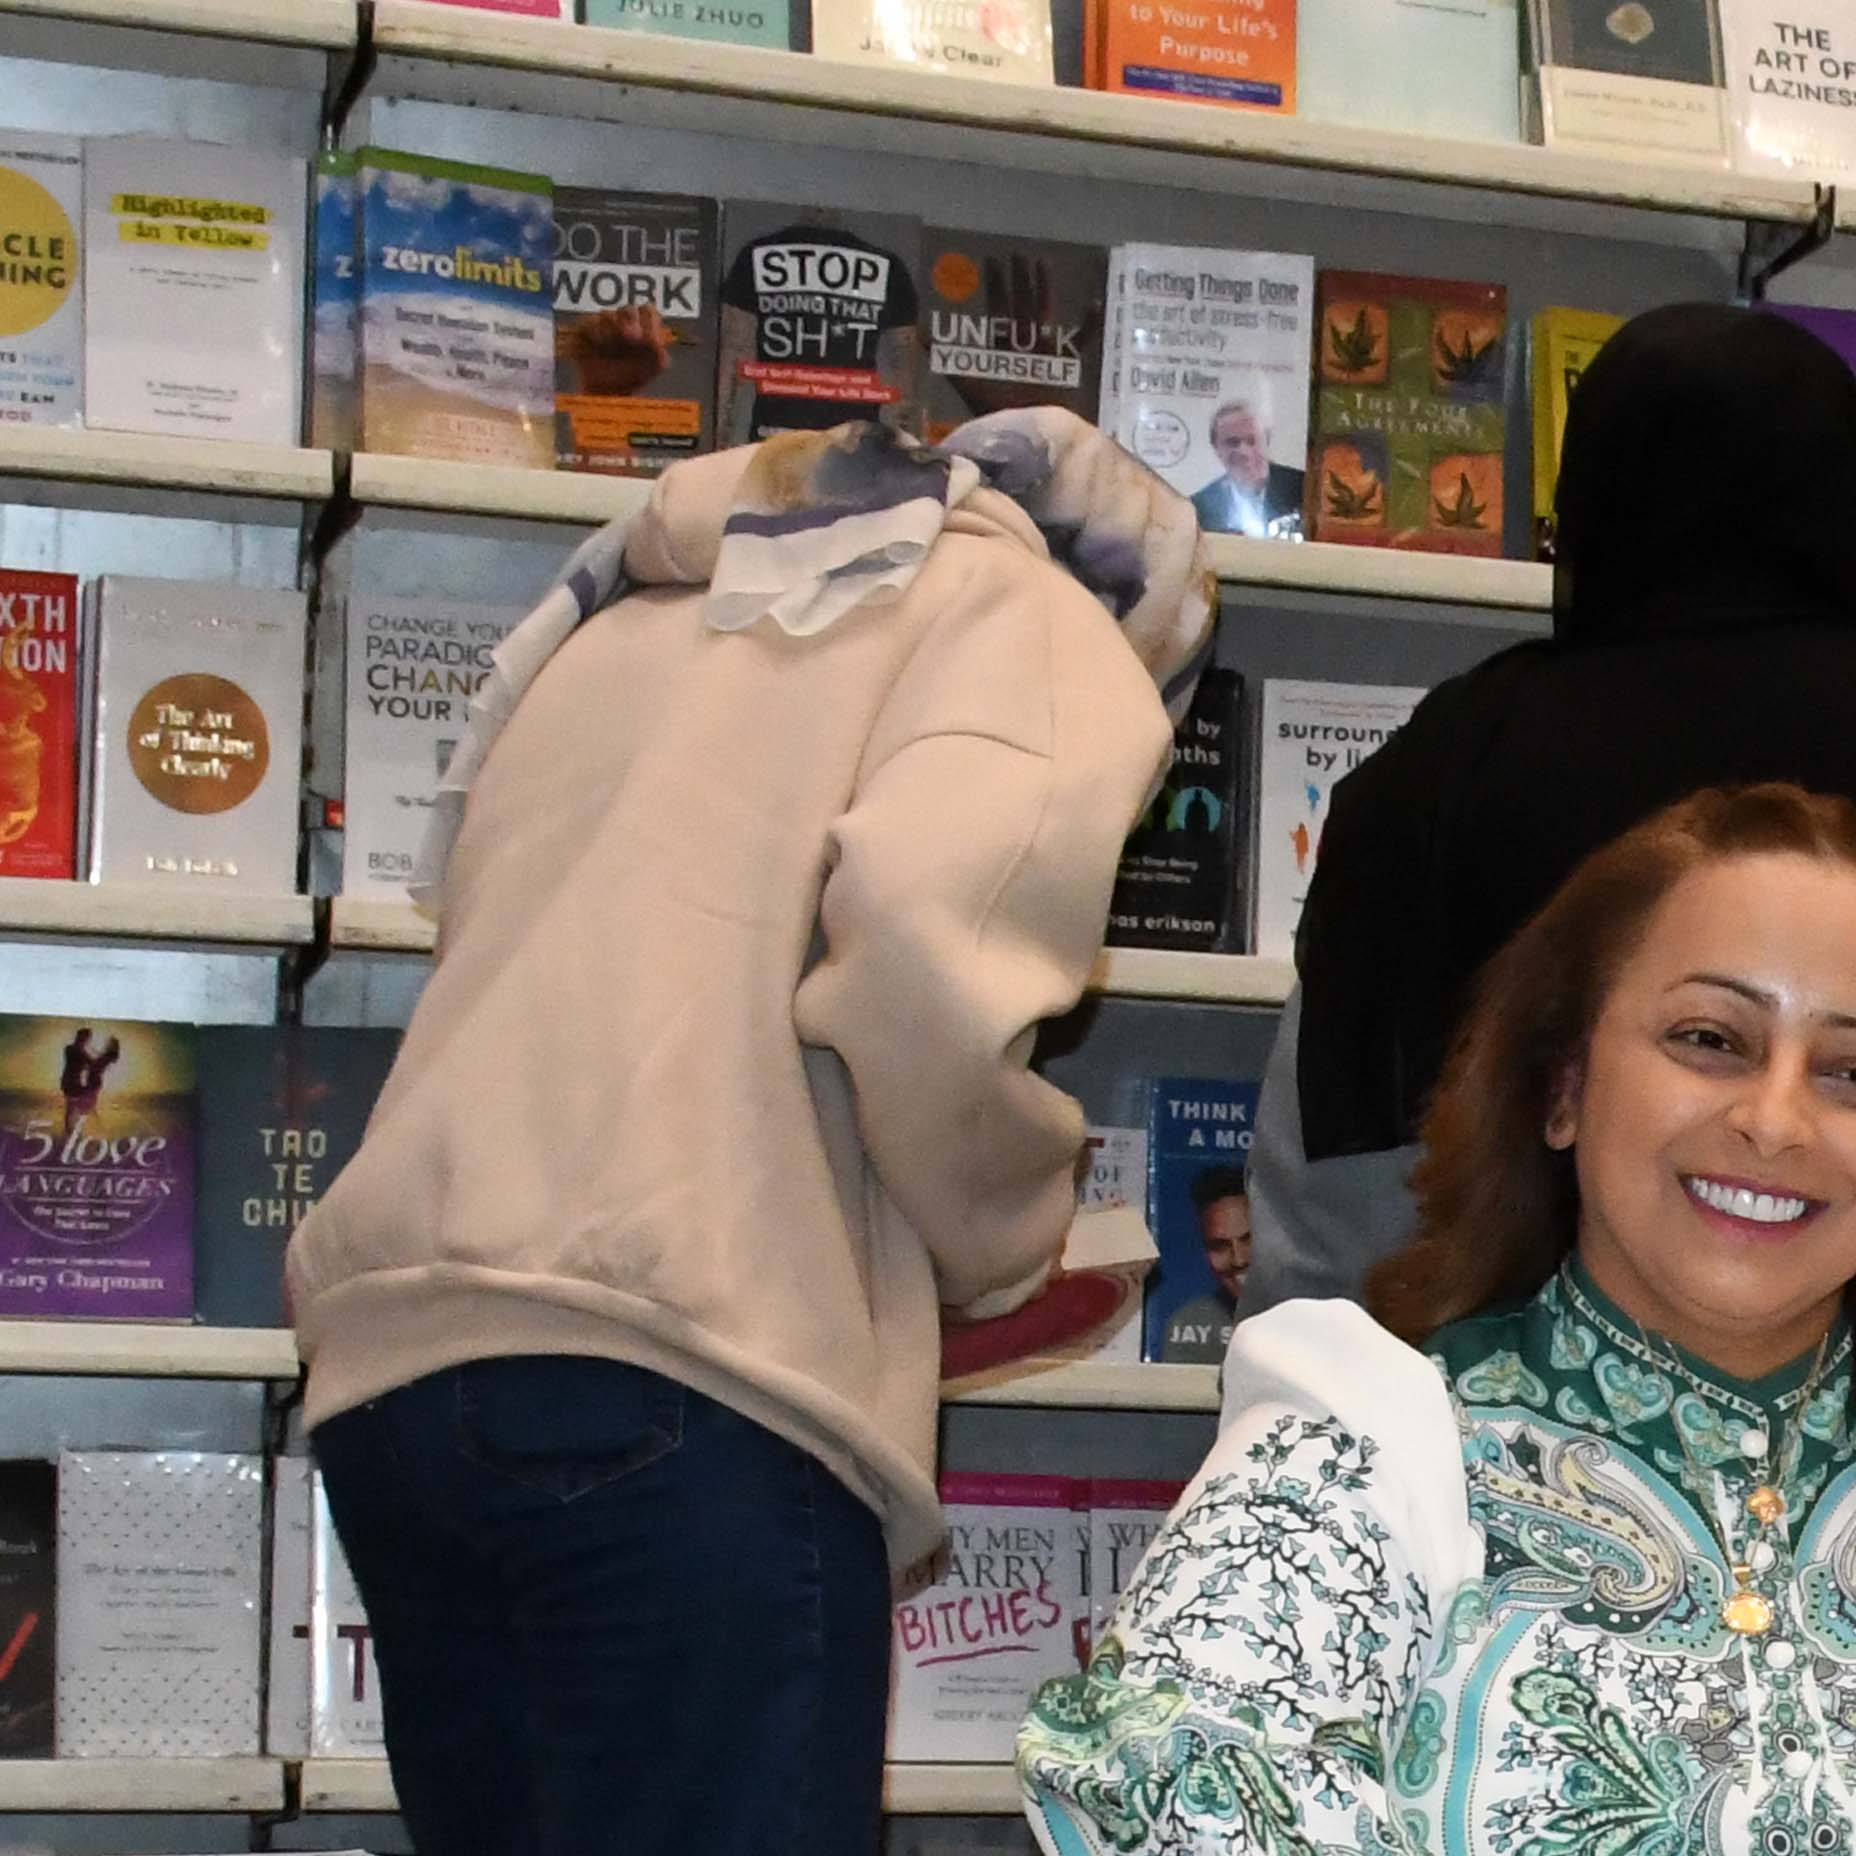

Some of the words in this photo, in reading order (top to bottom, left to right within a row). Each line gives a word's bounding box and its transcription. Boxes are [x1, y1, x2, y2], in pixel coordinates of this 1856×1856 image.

[1160, 36, 1248, 68] Purpose
[1774, 22, 1831, 52] THE
[1755, 48, 1813, 72] ART
[1819, 56, 1856, 80] OF
[381, 244, 542, 294] zerolimits
[760, 247, 880, 290] STOP
[759, 294, 825, 315] DOING
[831, 299, 883, 322] THAT
[937, 344, 1077, 385] YOURSELF
[367, 614, 458, 634] CHANGE
[368, 695, 450, 721] YOUR
[1306, 747, 1337, 772] by
[368, 853, 413, 872] BOB
[1168, 1100, 1246, 1122] THINK
[21, 1120, 54, 1165] 5
[62, 1115, 168, 1167] love
[260, 1128, 328, 1159] TAO
[271, 1163, 314, 1193] TE
[1169, 1324, 1213, 1345] JAY
[986, 1526, 1055, 1551] MEN
[896, 1579, 1062, 1651] BITCHES
